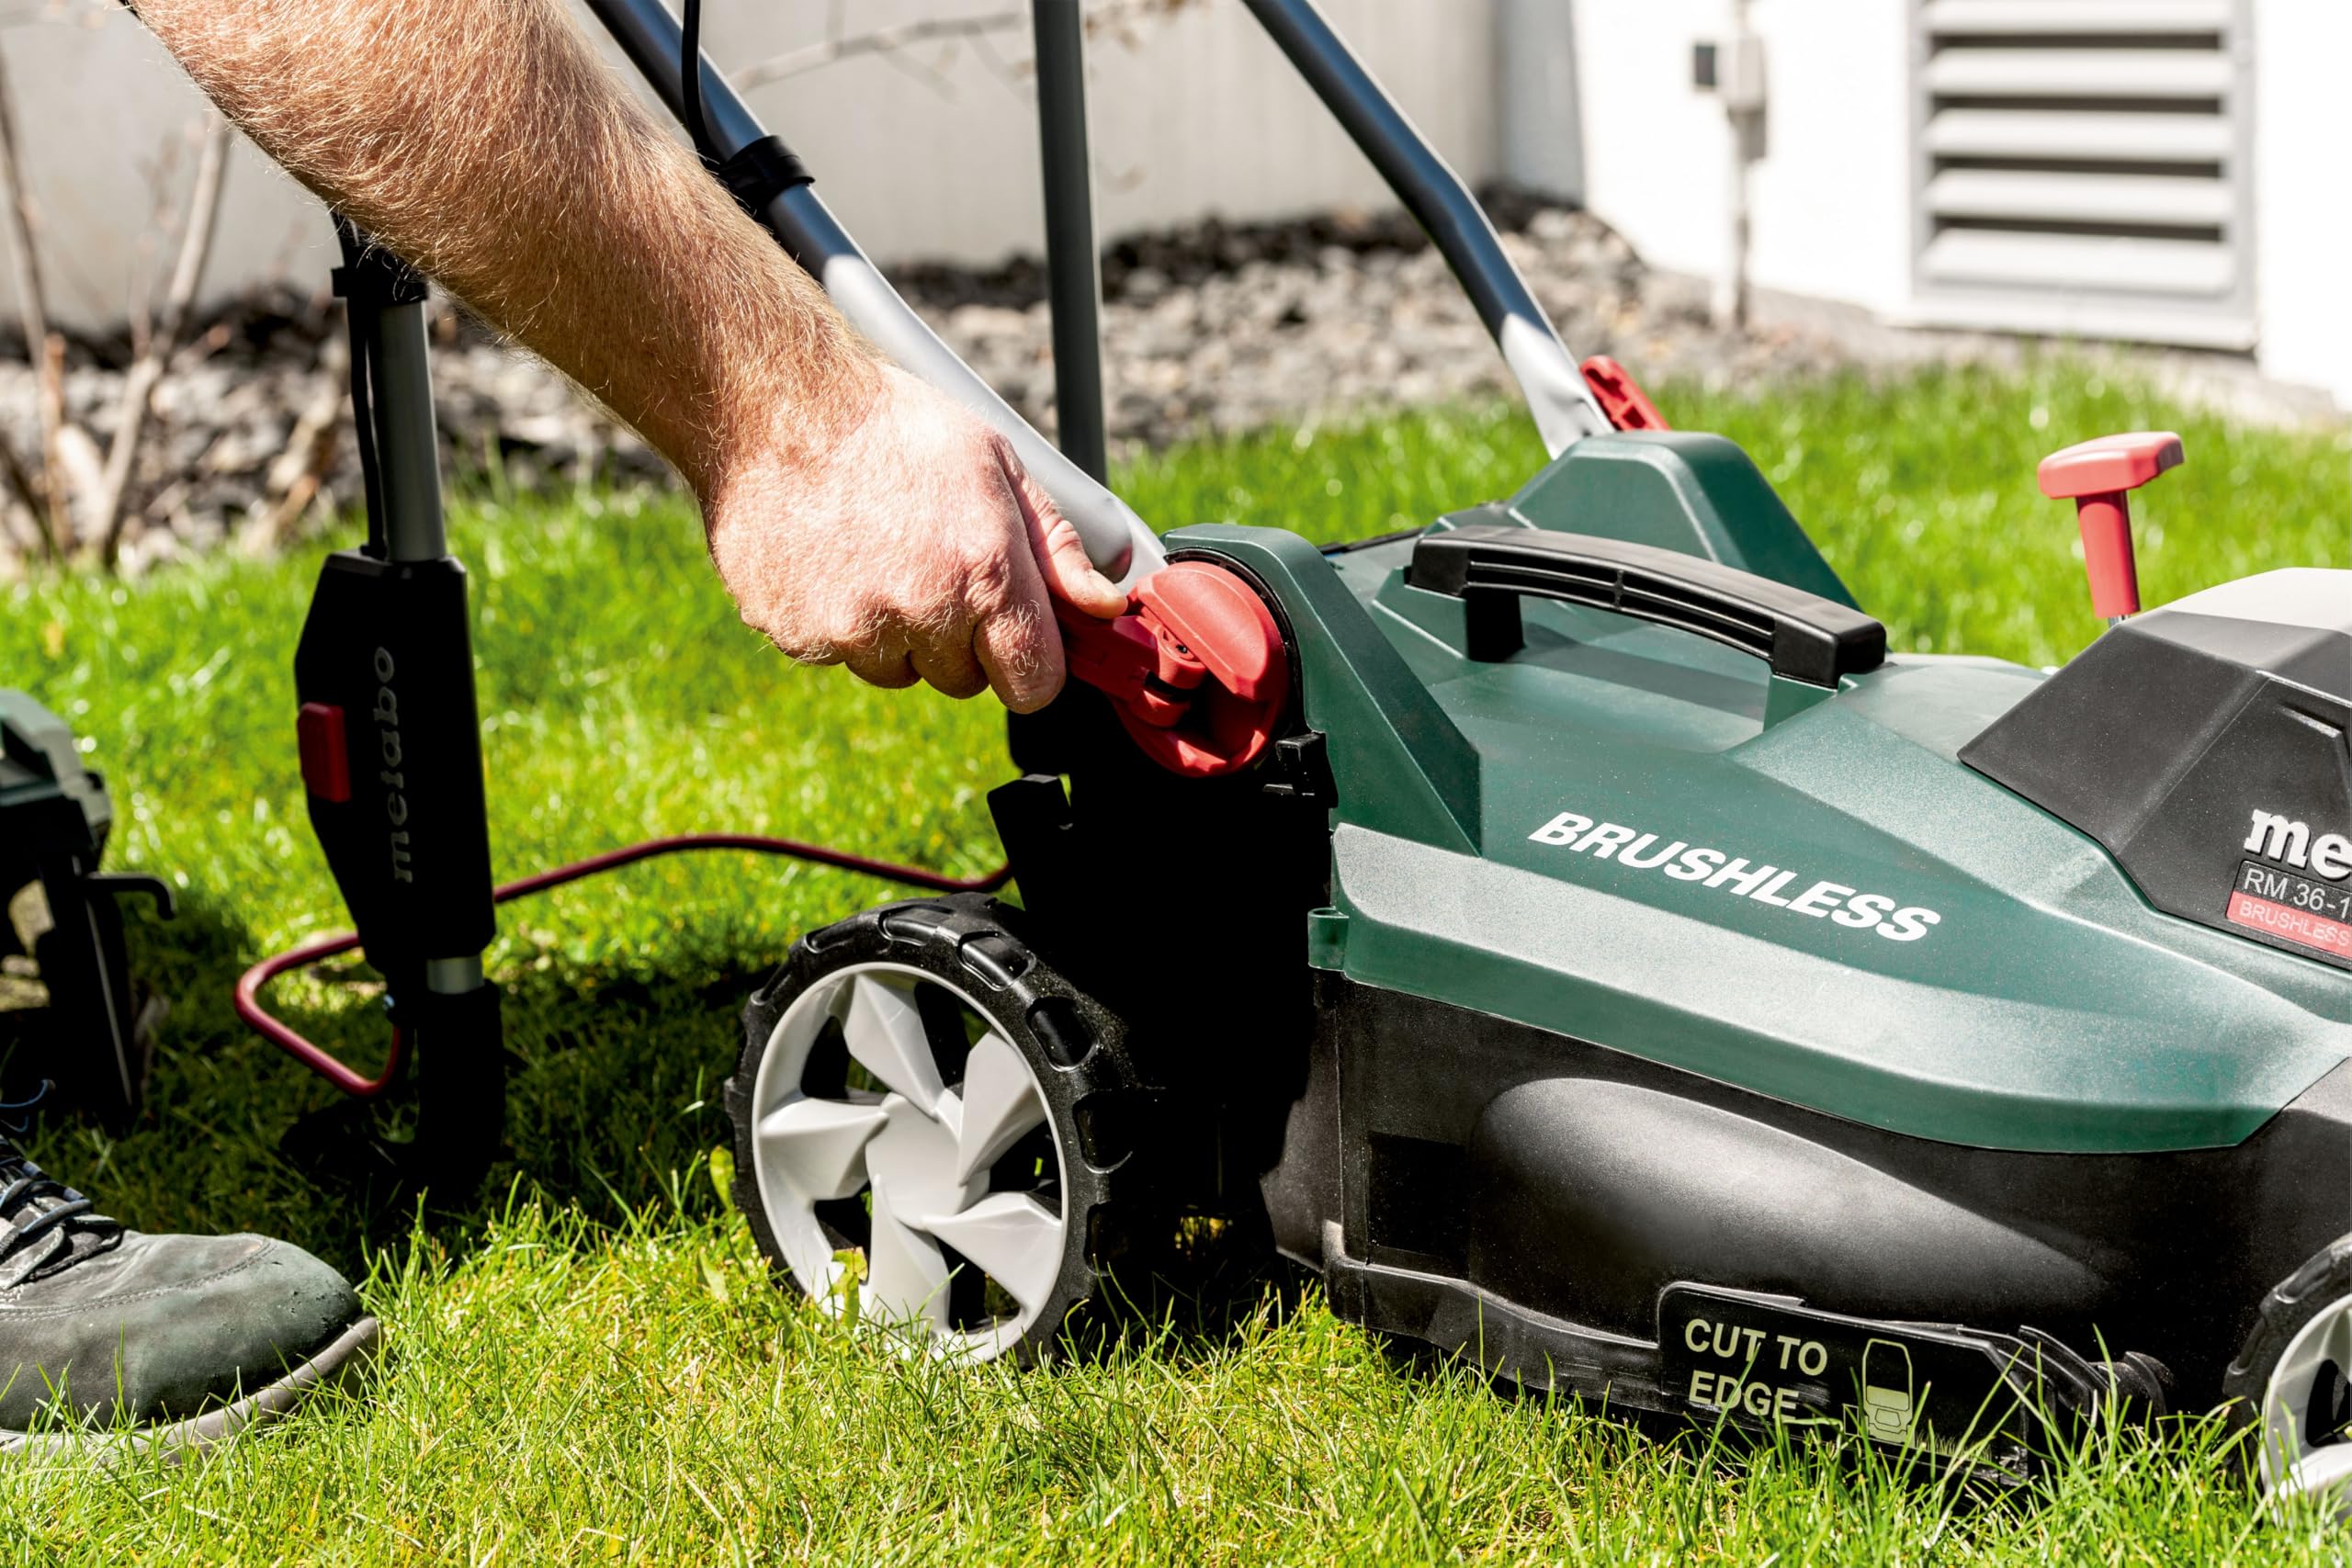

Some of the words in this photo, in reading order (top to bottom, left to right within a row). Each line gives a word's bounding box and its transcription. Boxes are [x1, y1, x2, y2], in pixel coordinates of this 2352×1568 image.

[374, 646, 413, 884] metabo
[1527, 811, 1941, 942] BRUSHLESS
[2244, 867, 2288, 900] RM
[2293, 883, 2350, 919] 36-1
[2239, 900, 2351, 946] BRUSHLESS
[1684, 1318, 1767, 1362] CUT
[1777, 1336, 1828, 1376] TO
[1689, 1370, 1800, 1422] EDGE
